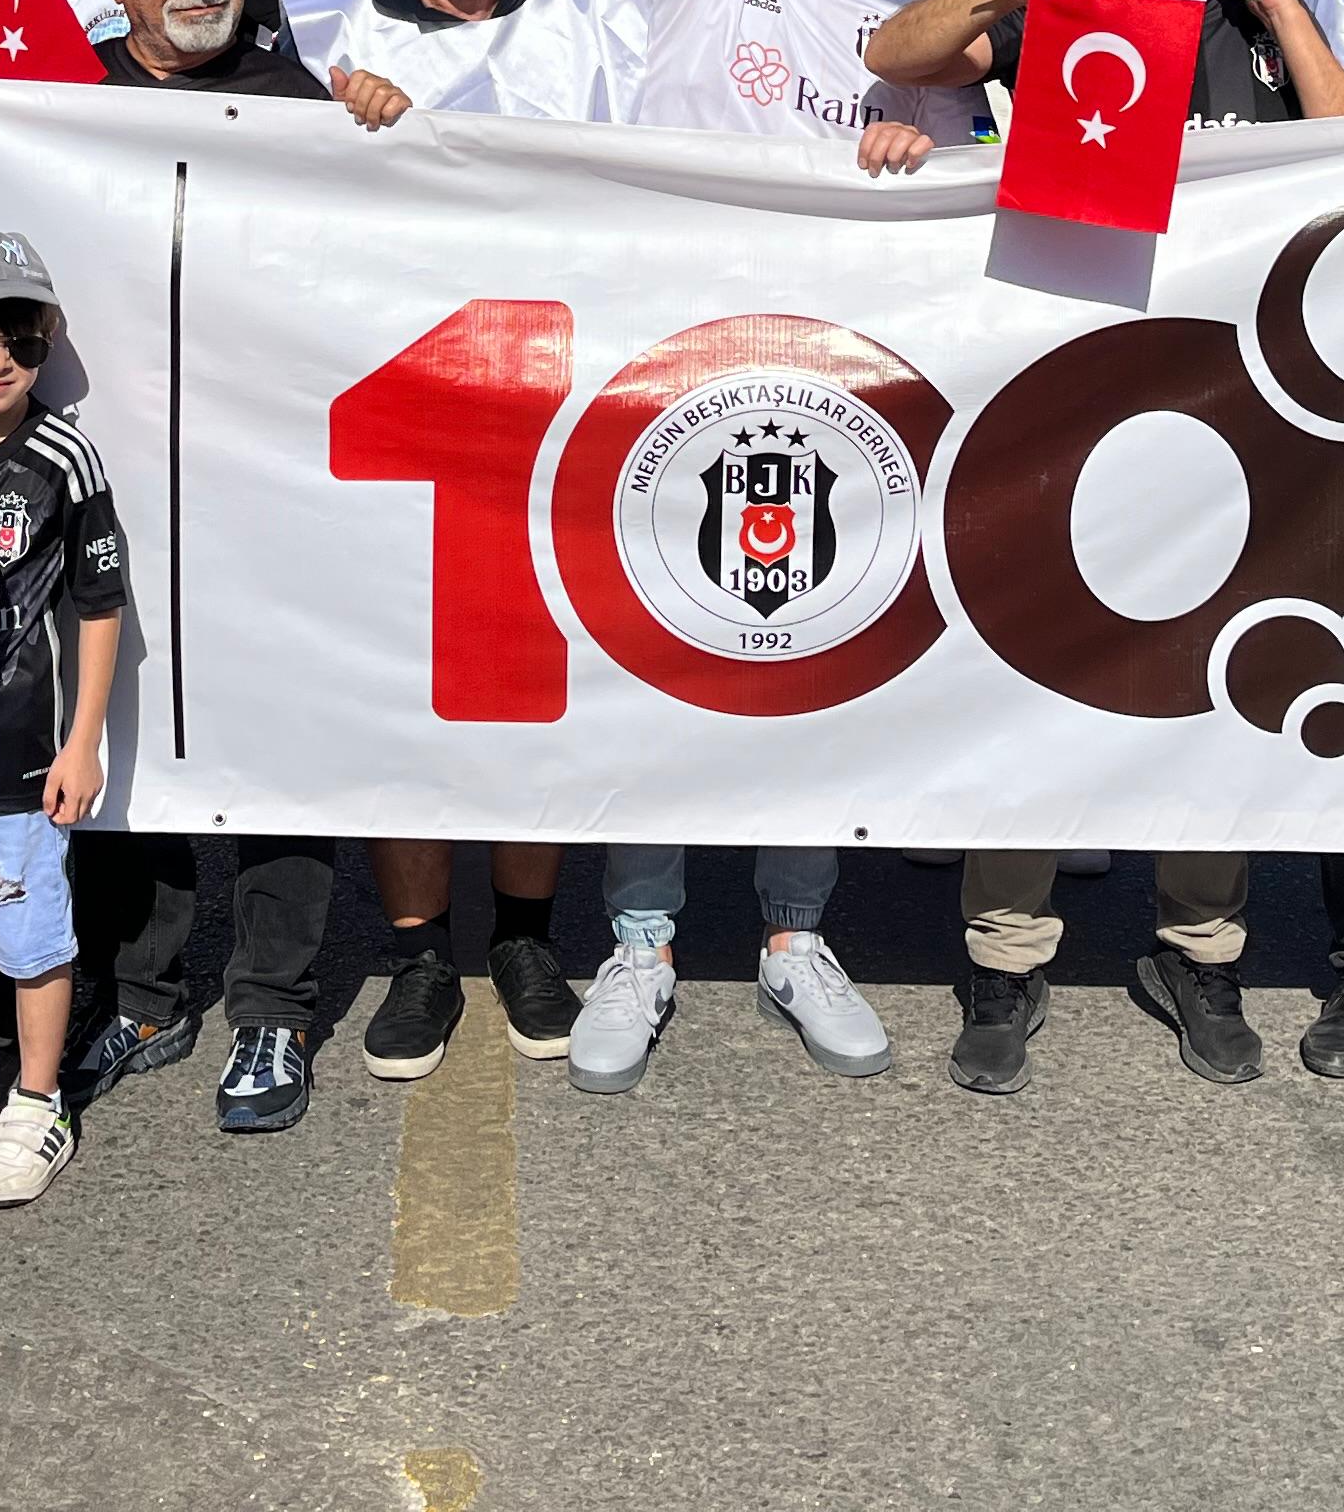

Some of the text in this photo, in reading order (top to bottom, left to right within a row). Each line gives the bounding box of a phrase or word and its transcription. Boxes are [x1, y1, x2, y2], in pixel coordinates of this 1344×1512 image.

[794, 75, 884, 131] Rain
[631, 384, 911, 496] MERSİN BEŞİKTAŞLILAR DERNEĞİ
[724, 463, 813, 497] BJK
[85, 530, 116, 559] NES
[729, 567, 808, 593] 1903
[738, 632, 793, 650] 1992
